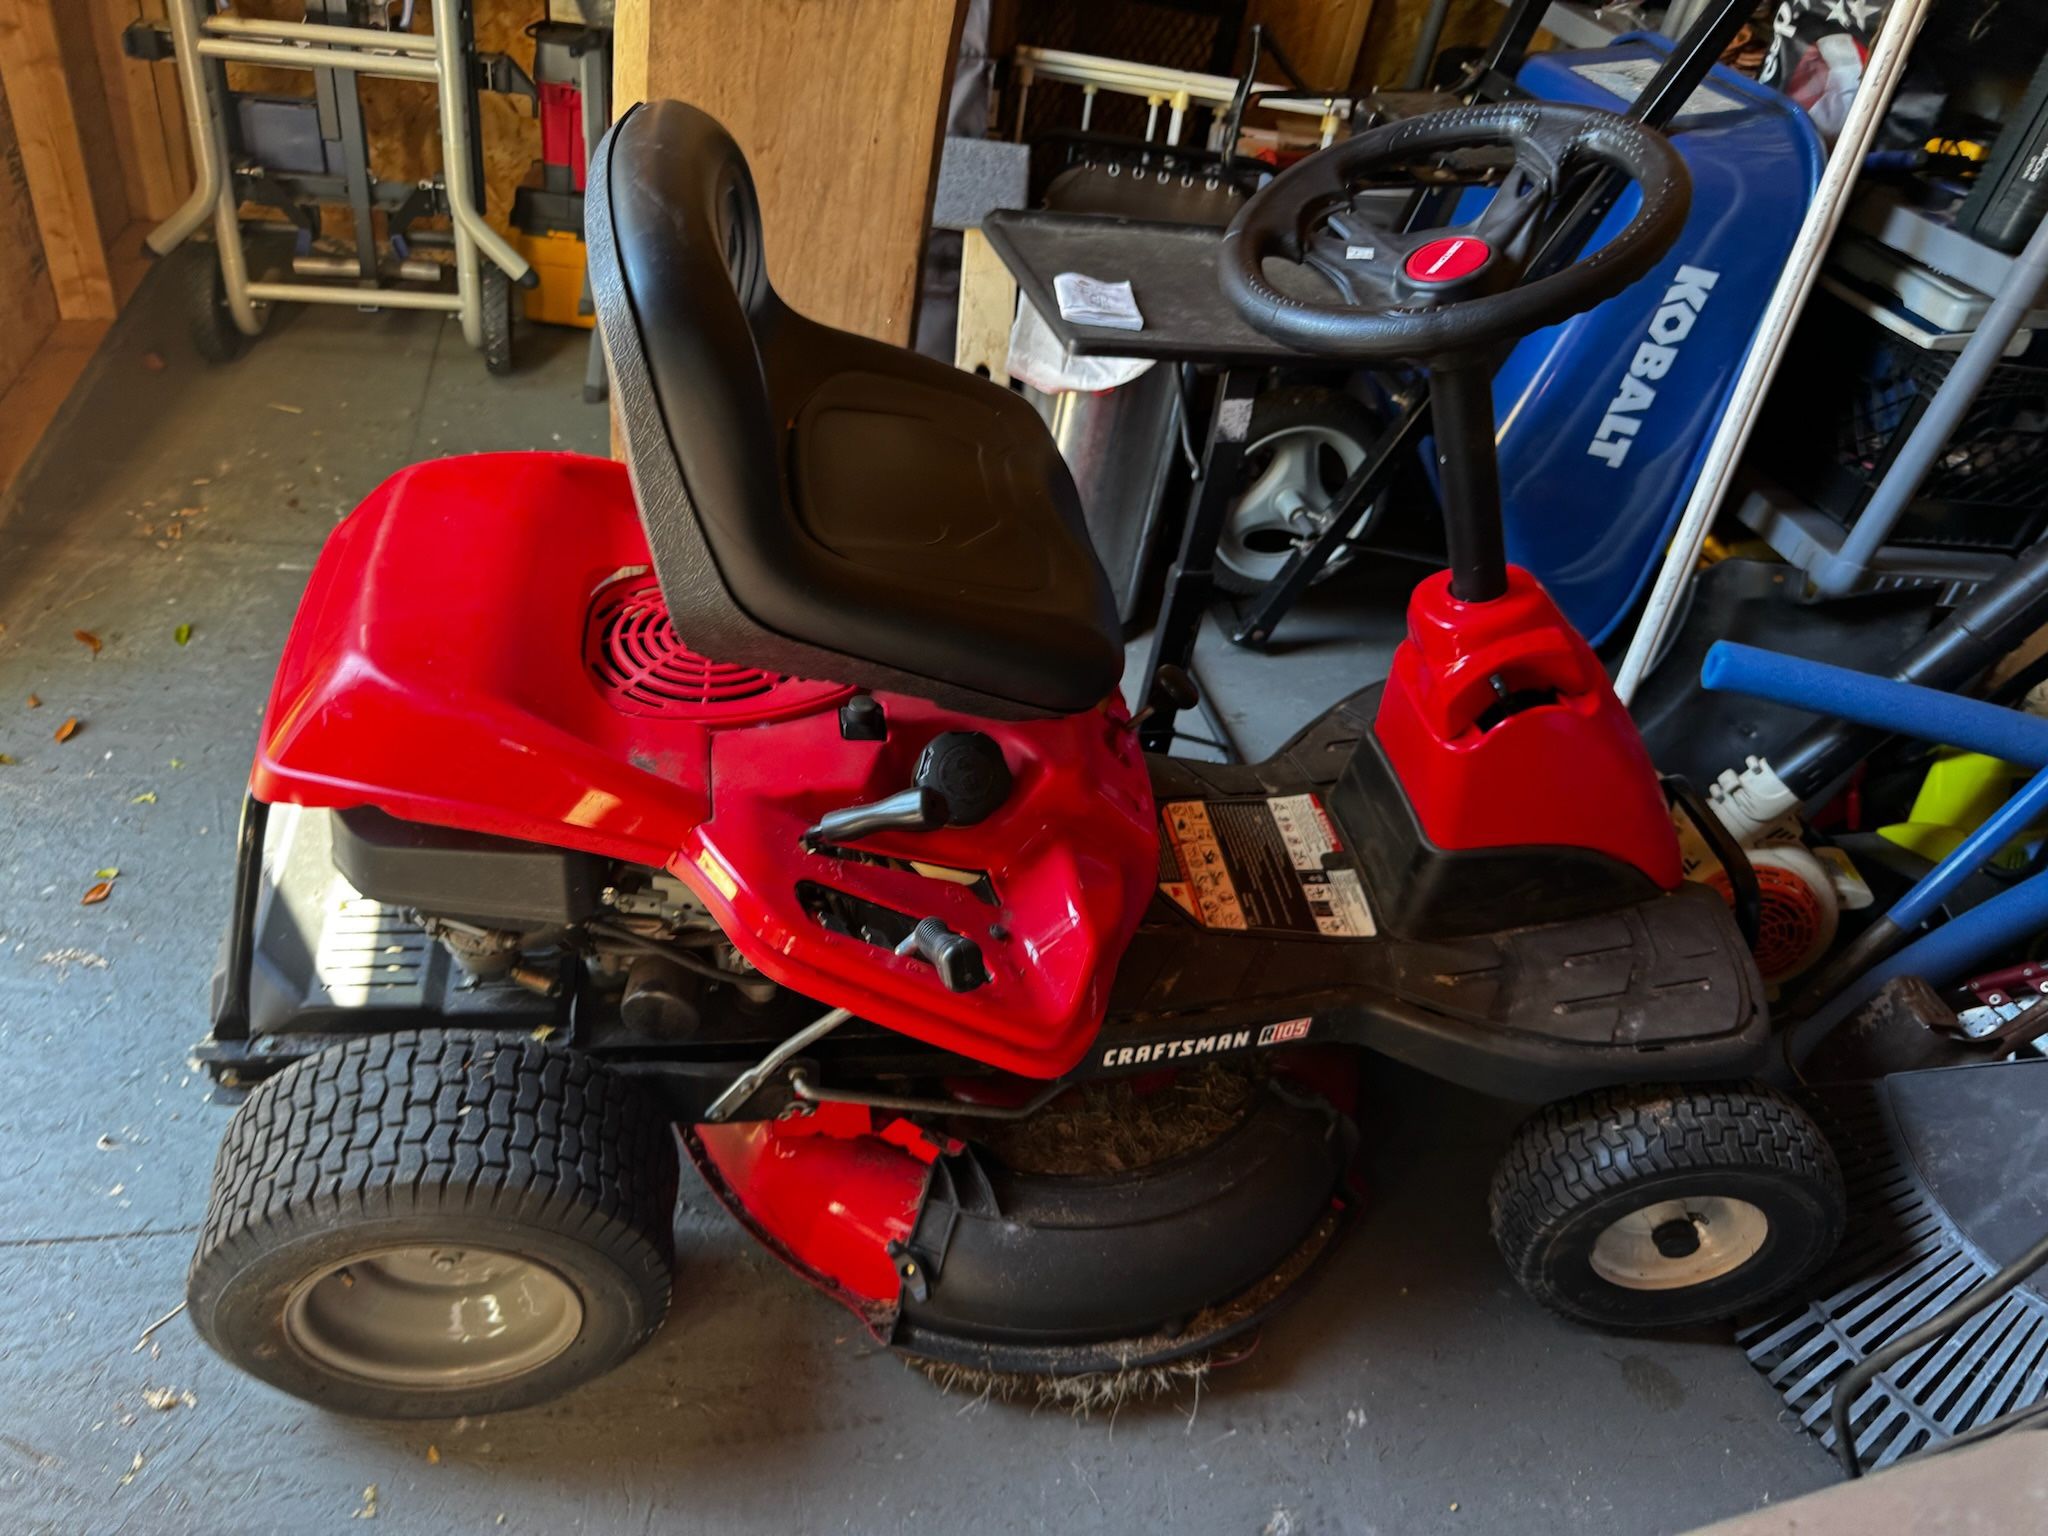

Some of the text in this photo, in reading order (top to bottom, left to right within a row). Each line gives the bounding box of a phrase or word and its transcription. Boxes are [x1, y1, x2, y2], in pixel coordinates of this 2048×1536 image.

[1586, 264, 1721, 469] KOBALT
[1103, 1017, 1312, 1067] CRAFTSMAN R105
